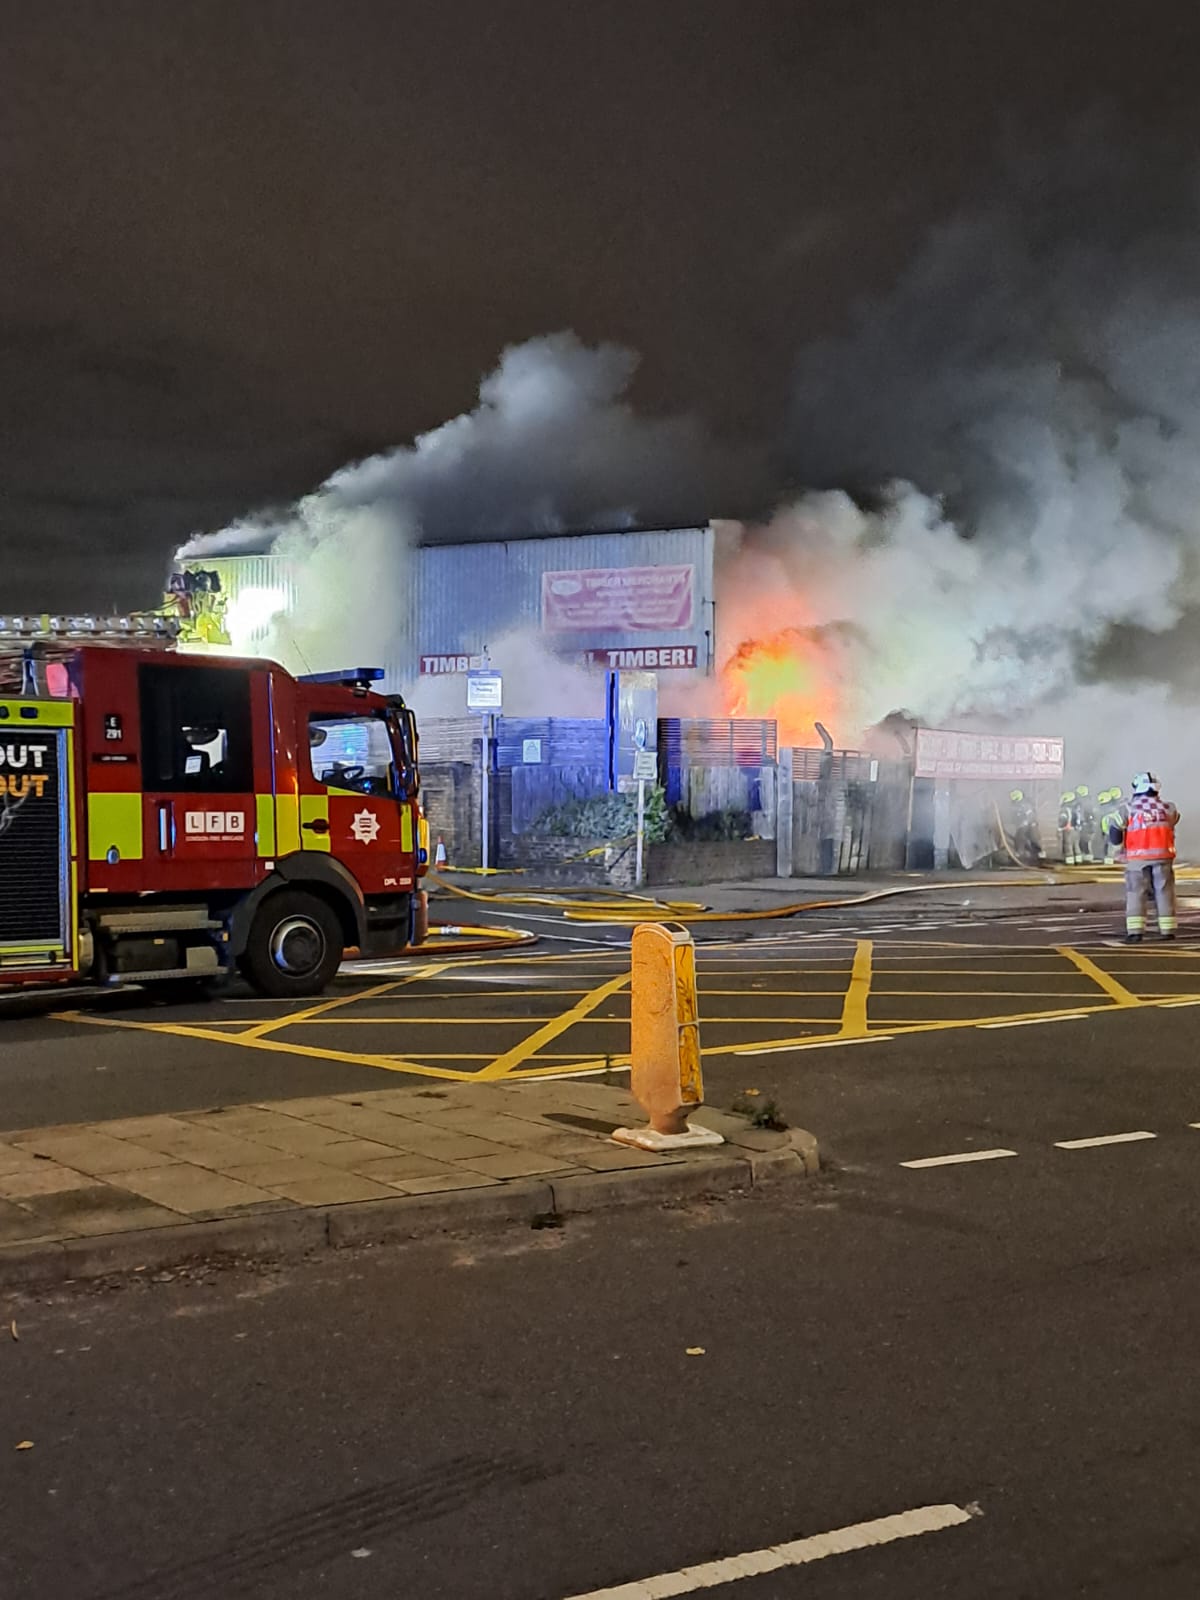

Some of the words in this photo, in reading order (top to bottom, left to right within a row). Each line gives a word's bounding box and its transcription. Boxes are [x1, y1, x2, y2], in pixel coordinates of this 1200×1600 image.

[423, 656, 484, 673] TIMBE
[607, 648, 693, 668] TIMBER!
[0, 744, 47, 768] UT
[190, 815, 240, 829] LFB
